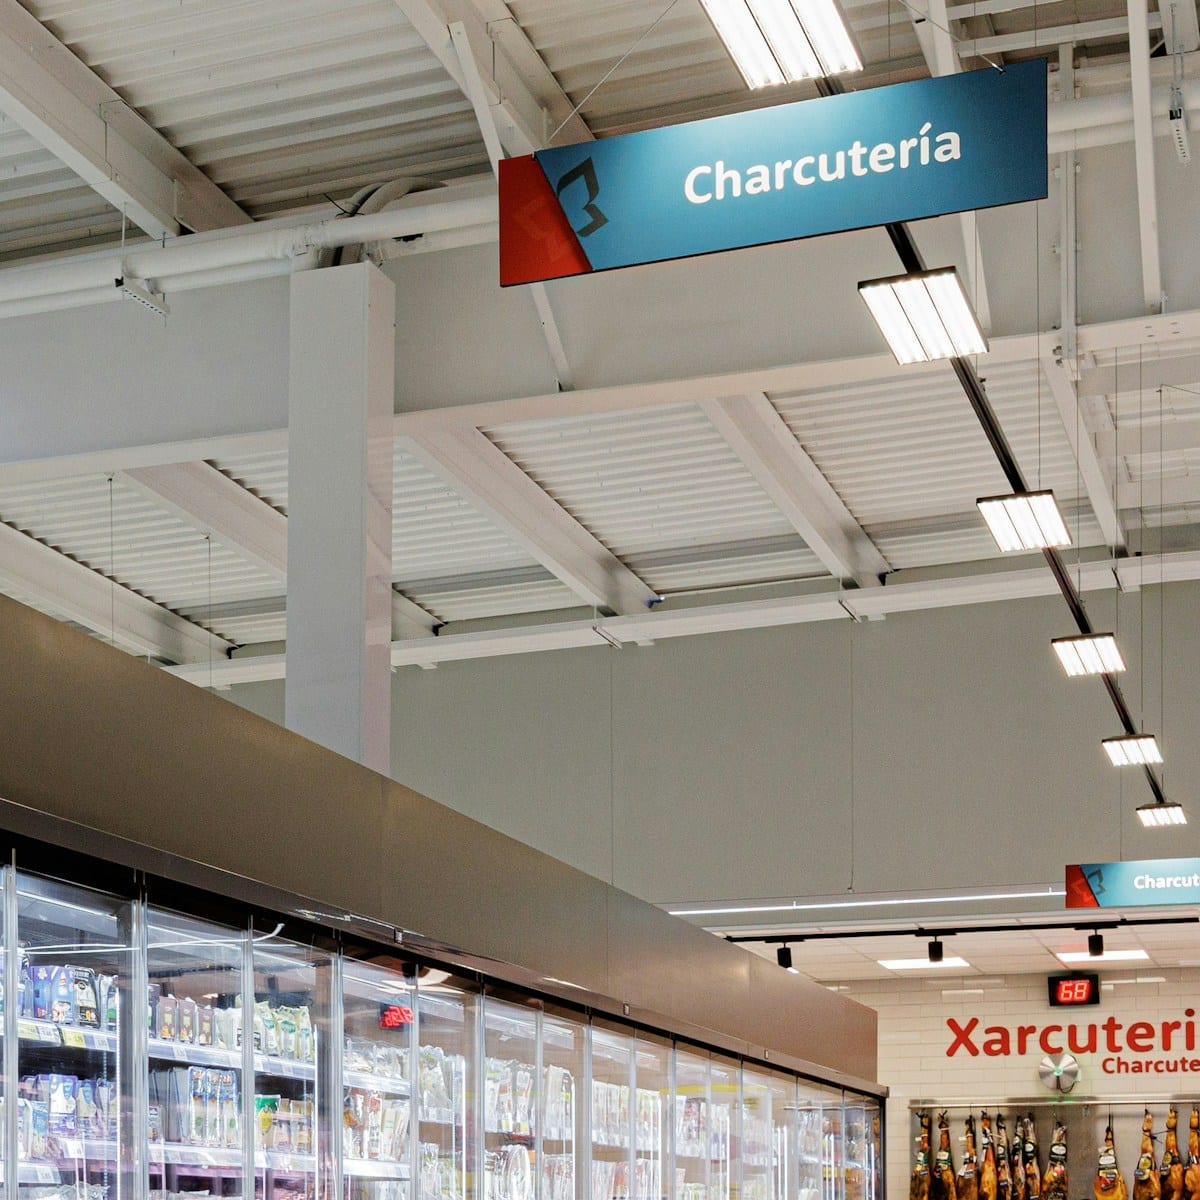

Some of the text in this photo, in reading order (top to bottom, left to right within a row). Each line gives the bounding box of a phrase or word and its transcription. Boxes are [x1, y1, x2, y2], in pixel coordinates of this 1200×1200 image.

[684, 121, 963, 205] Charcutería
[1134, 873, 1200, 889] Charcut
[1060, 982, 1088, 1001] 68
[946, 1008, 1196, 1057] Xarcuteri
[1102, 1056, 1200, 1074] Charcute
